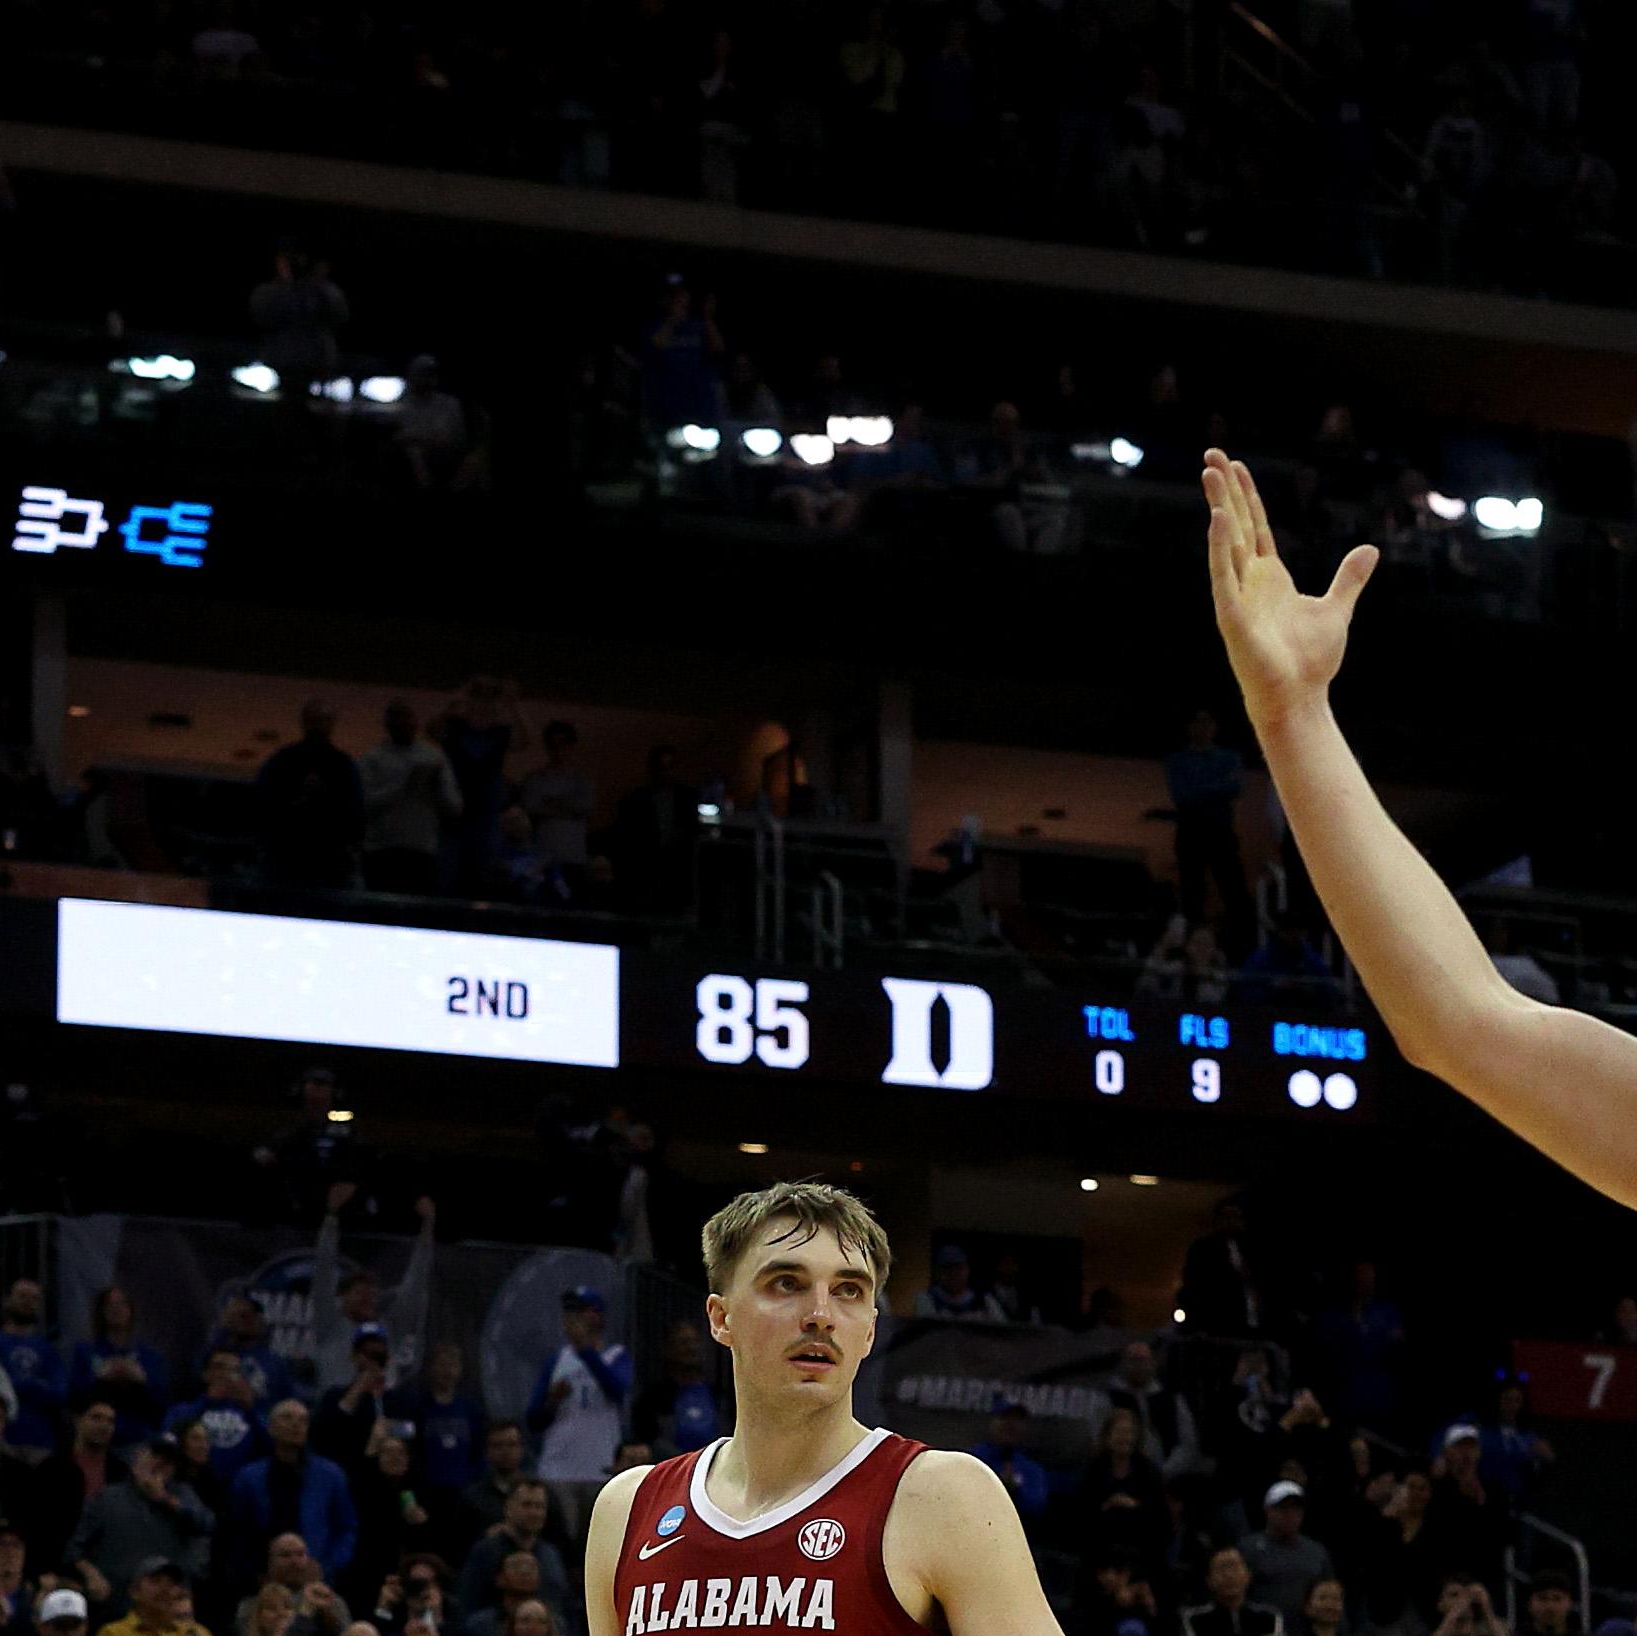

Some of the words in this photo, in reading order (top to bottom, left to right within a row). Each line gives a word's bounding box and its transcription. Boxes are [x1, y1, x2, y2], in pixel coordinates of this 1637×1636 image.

[449, 978, 529, 1020] 2ND
[695, 973, 810, 1070] 85
[881, 976, 994, 1091] D
[1081, 1004, 1136, 1042] TOL
[1178, 1013, 1230, 1050] FLS
[1271, 1021, 1367, 1062] BONUS
[1095, 1049, 1125, 1095] 0
[1191, 1058, 1221, 1103] 9
[1582, 1354, 1617, 1409] 7
[803, 1521, 842, 1557] SEC
